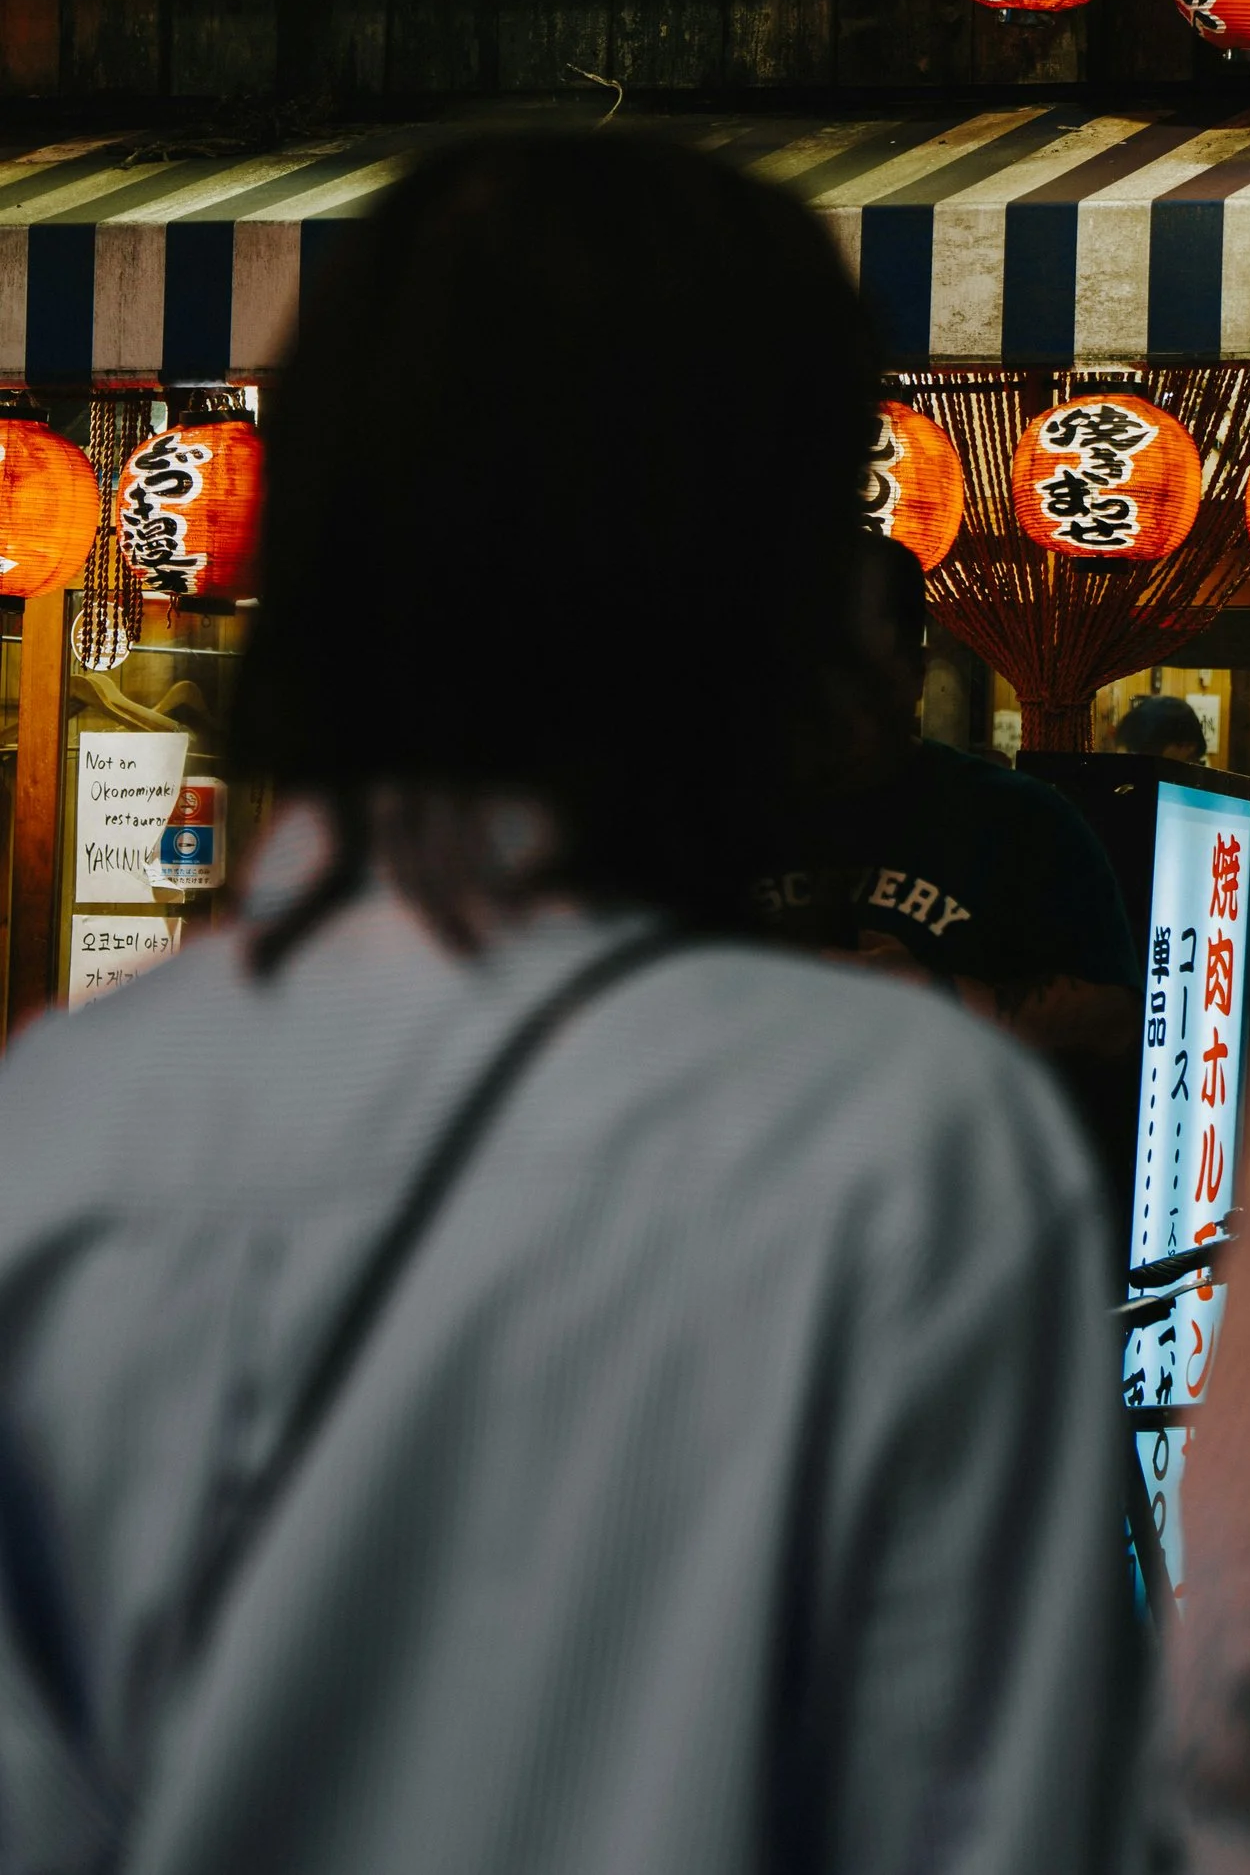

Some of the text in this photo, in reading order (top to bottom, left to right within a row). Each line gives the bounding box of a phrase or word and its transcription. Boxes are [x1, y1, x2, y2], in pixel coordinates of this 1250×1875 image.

[86, 751, 137, 770] Not an
[91, 780, 175, 802] Okonomiyaki
